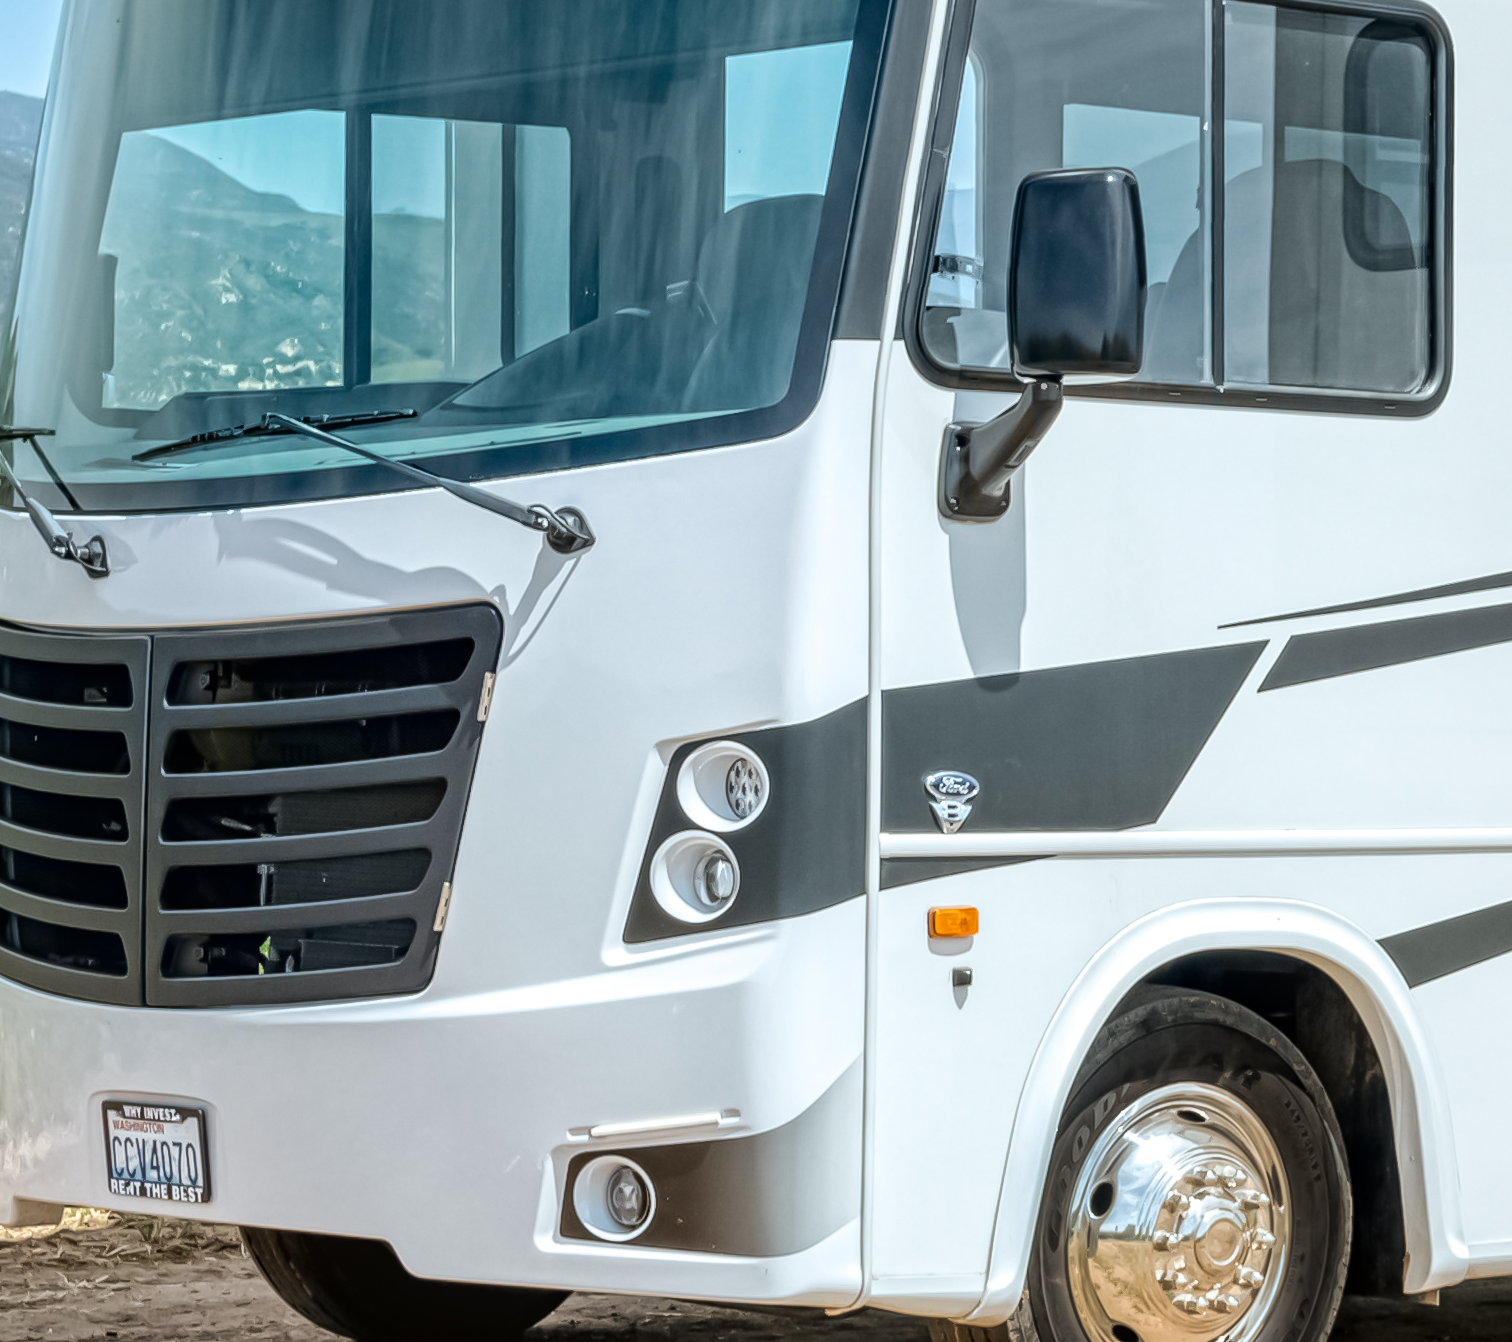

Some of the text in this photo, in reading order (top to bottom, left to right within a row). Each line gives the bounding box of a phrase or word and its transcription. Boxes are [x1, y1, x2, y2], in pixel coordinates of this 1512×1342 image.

[939, 776, 970, 795] Ford
[123, 1105, 141, 1118] WHY
[112, 1120, 165, 1134] WASHINGTON
[112, 1136, 198, 1187] CCV4070
[111, 1179, 203, 1203] RENT THE BEST
